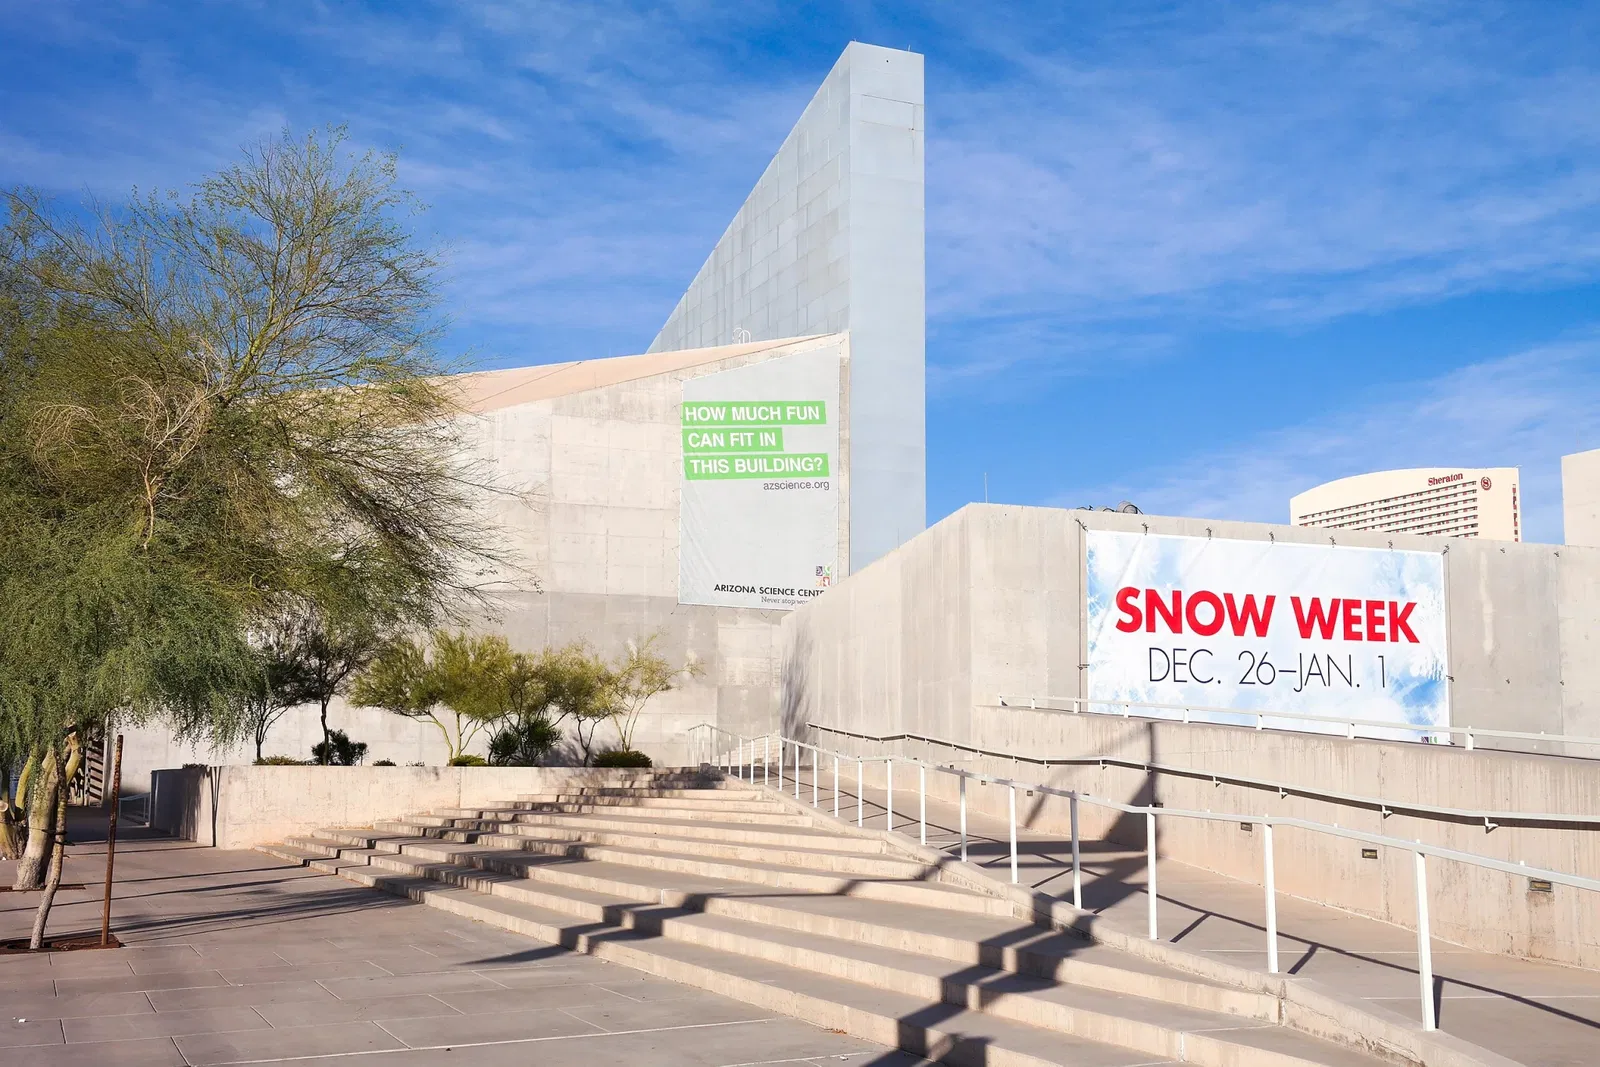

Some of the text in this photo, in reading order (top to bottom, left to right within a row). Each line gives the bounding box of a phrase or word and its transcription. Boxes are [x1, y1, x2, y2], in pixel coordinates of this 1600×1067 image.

[685, 405, 820, 421] HOW MUCH FUN
[688, 432, 776, 448] CAN FIT IN
[690, 457, 823, 474] THIS BUILDING?
[763, 480, 830, 490] azscience.org
[1427, 473, 1463, 486] Sheraton
[714, 584, 756, 594] ARIZONA
[759, 586, 795, 596] SCIENCE
[761, 596, 780, 604] Never
[1115, 586, 1420, 643] SNOW WEEK
[1149, 647, 1221, 685] DEC.
[1378, 655, 1386, 688] 1
